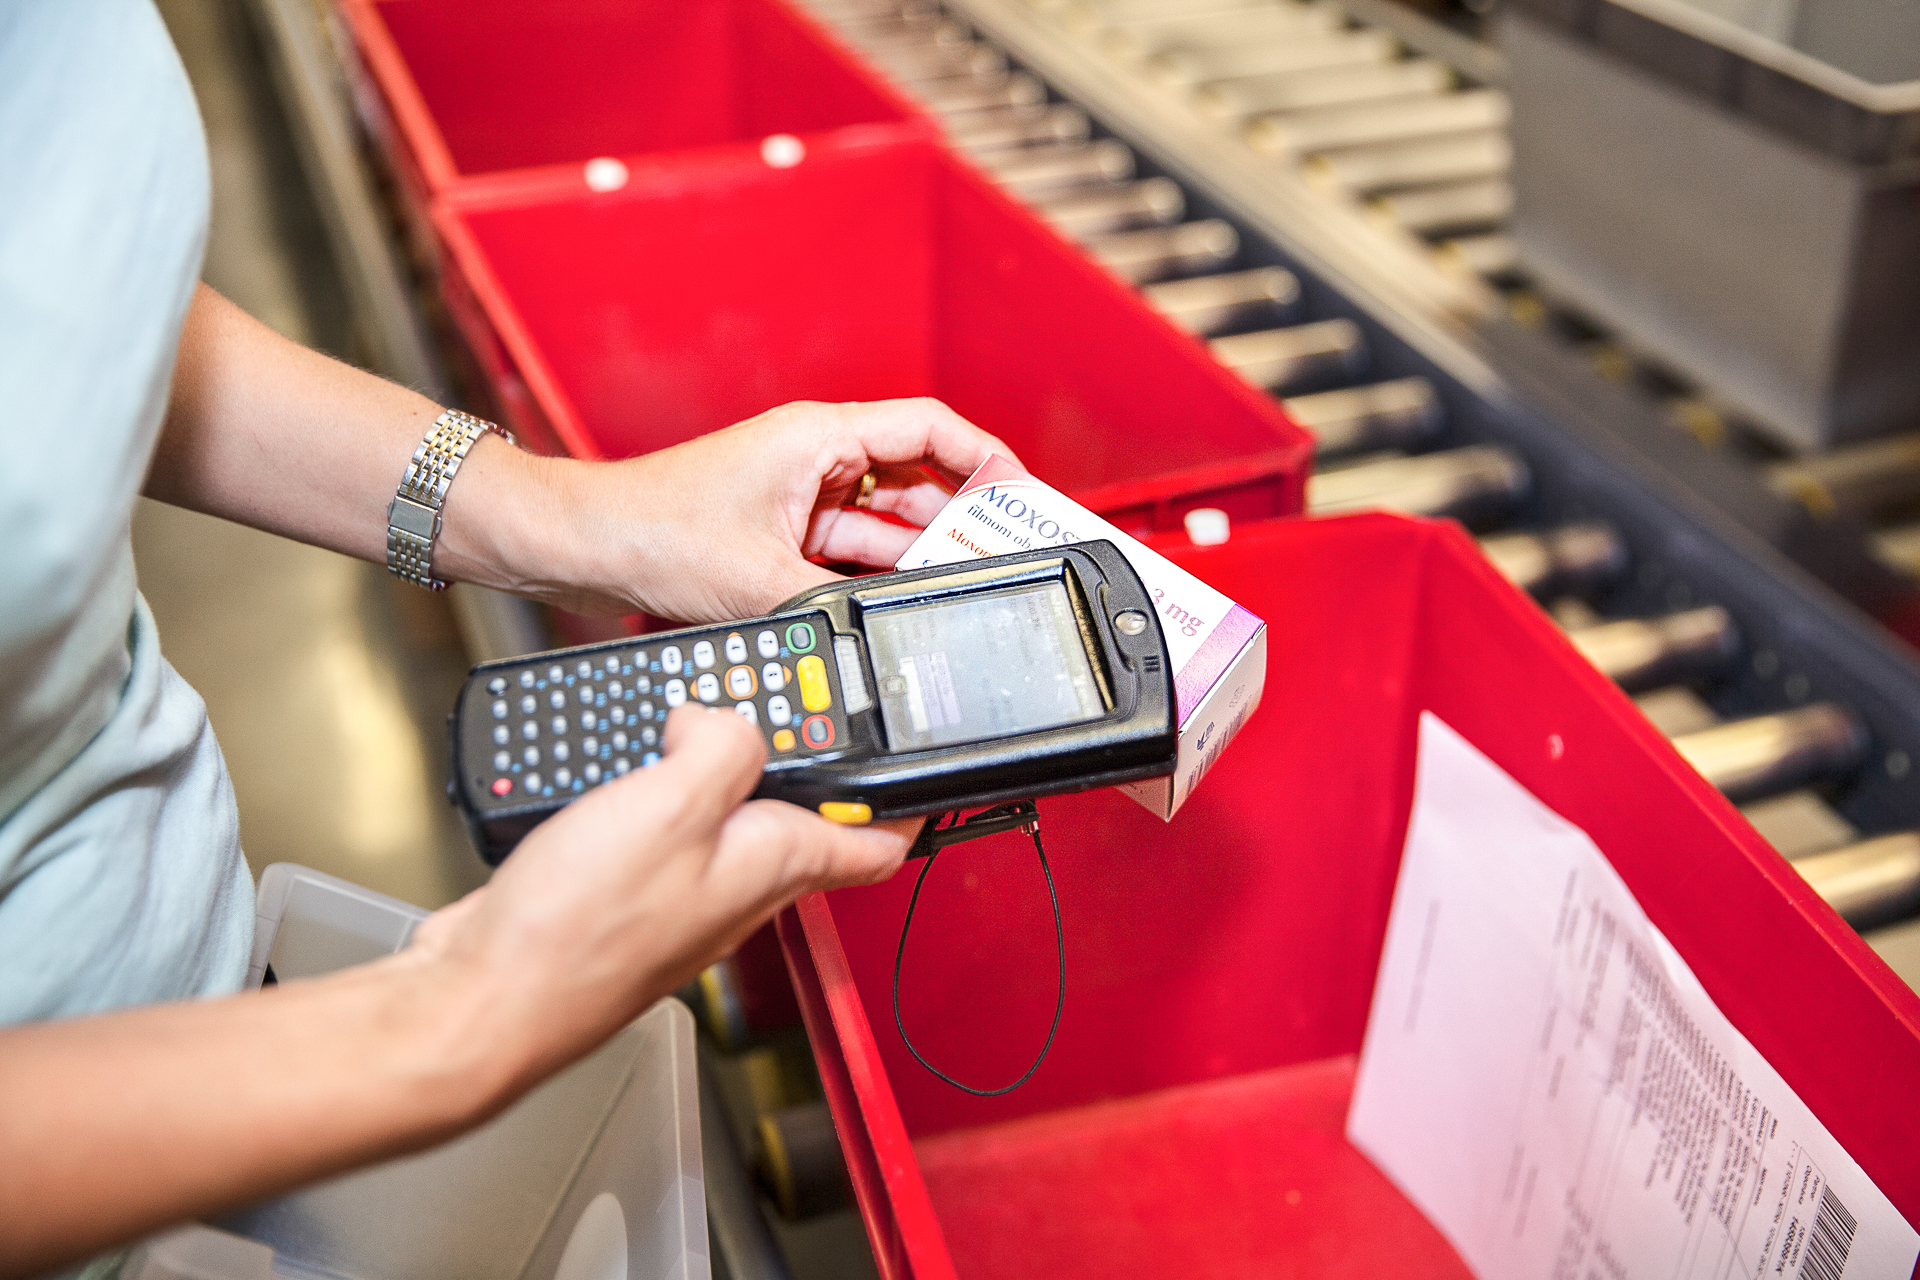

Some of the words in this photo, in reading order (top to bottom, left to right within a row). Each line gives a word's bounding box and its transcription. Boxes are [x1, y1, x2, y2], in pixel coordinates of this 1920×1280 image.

[967, 503, 1012, 539] filmom
[981, 485, 1081, 545] MOXOS
[1164, 602, 1205, 637] mg
